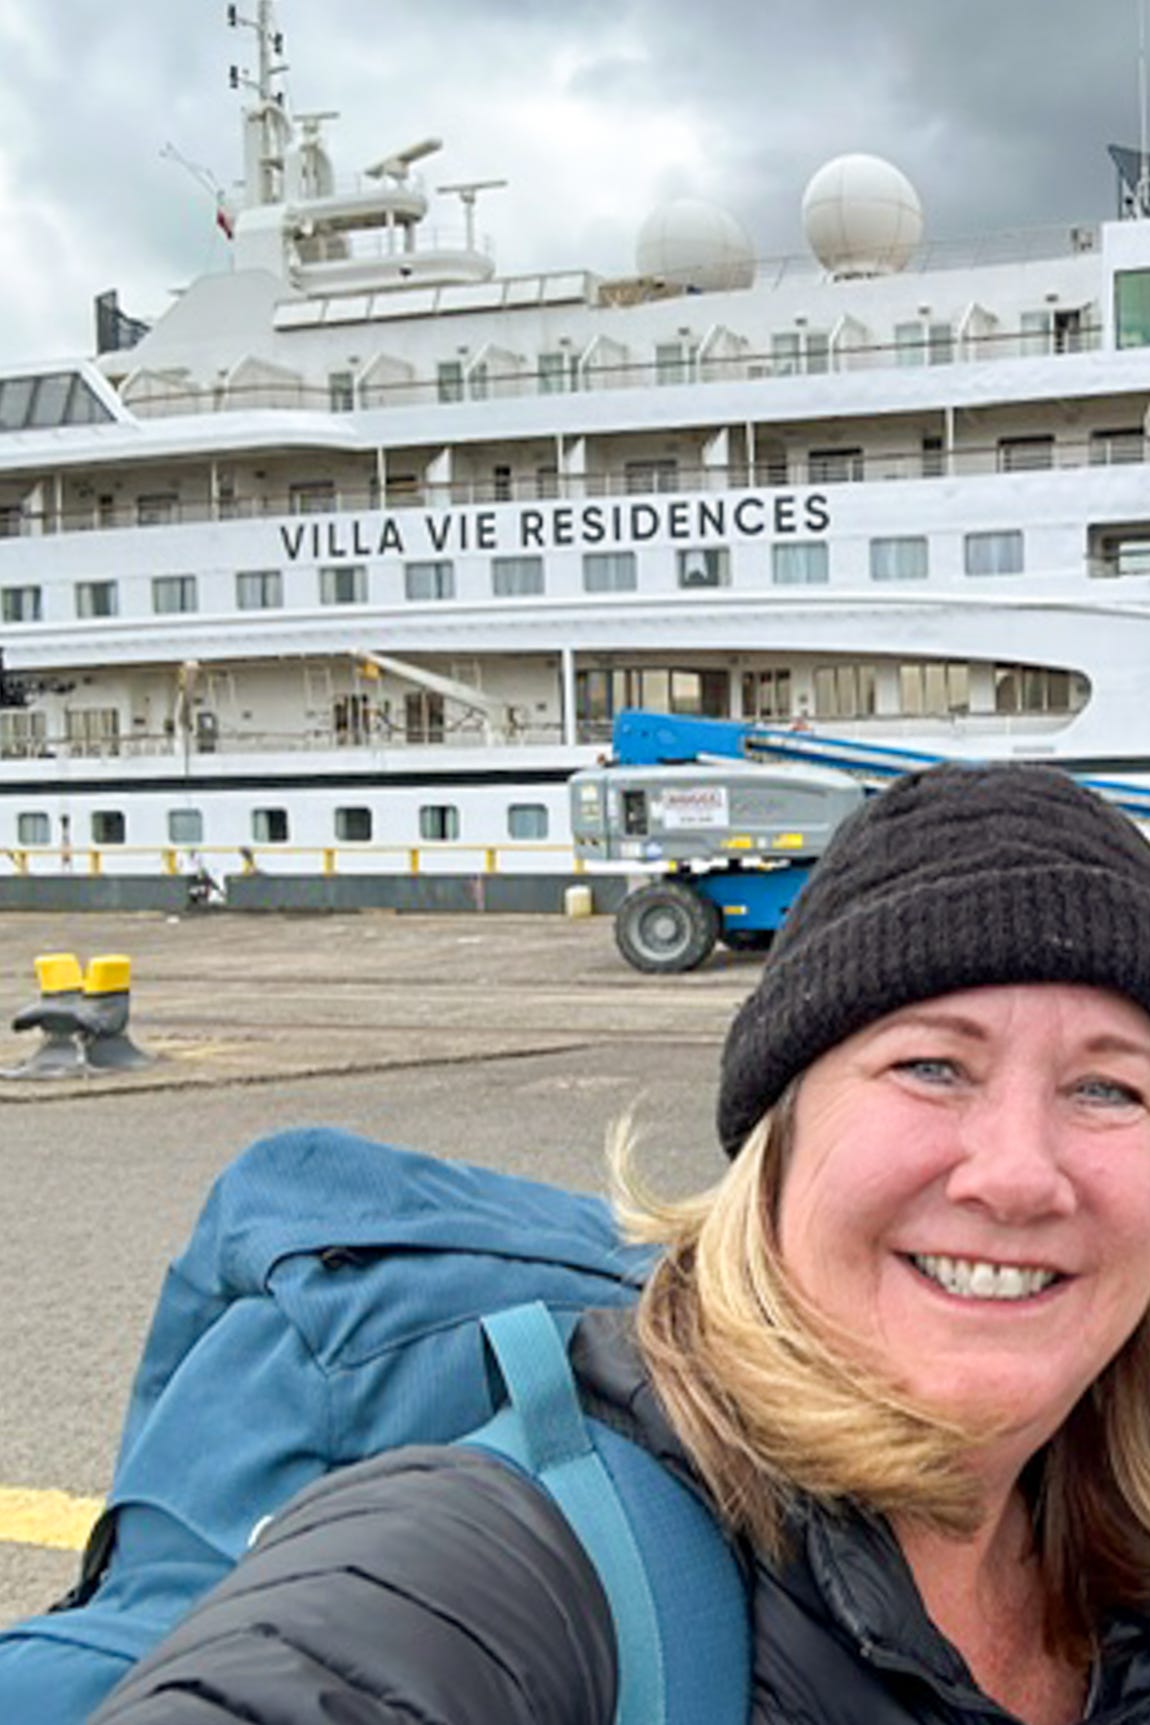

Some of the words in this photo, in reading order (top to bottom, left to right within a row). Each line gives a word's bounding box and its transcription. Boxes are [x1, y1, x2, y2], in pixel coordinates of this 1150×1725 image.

[279, 517, 405, 561] VILLA
[424, 511, 498, 552] VIE
[519, 493, 831, 548] RESIDENCES
